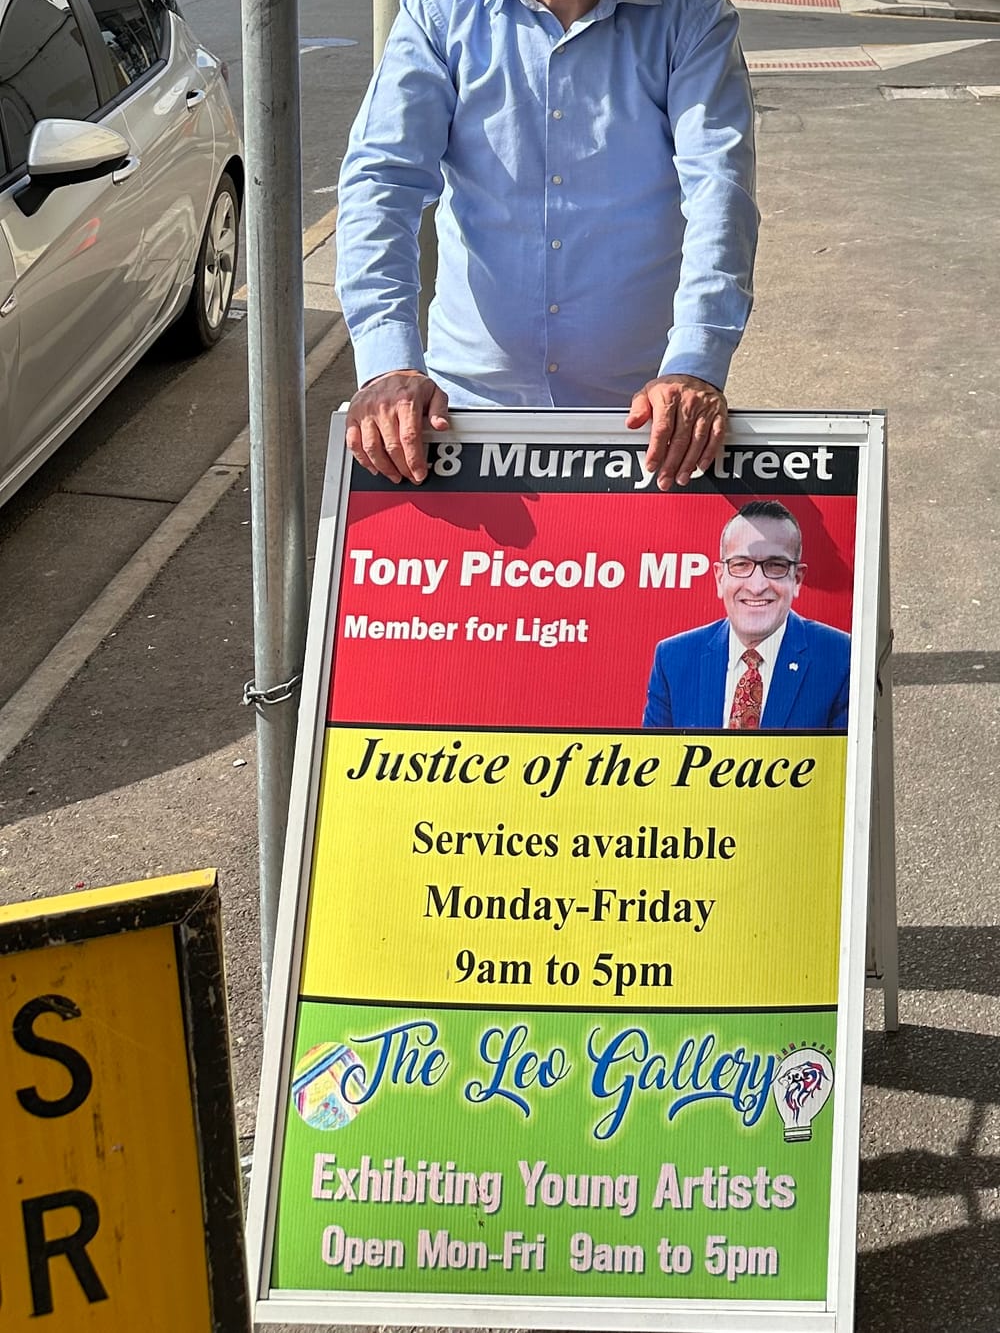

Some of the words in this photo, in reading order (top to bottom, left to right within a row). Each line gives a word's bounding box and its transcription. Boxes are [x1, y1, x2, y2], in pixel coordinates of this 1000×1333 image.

[479, 443, 656, 490] Murray
[690, 446, 834, 481] treet
[350, 550, 449, 594] Tony
[460, 550, 625, 589] Piccolo
[639, 552, 710, 589] MP
[344, 615, 459, 641] Member
[465, 615, 508, 641] for
[515, 617, 588, 647] Light
[347, 736, 508, 787] Justice
[523, 741, 583, 798] of
[587, 742, 658, 787] the
[672, 744, 816, 788] Peace
[413, 820, 559, 859] Services
[572, 827, 737, 860] available
[424, 883, 716, 932] Monday-Friday
[456, 949, 532, 986] 9am
[546, 955, 579, 986] to
[593, 952, 673, 997] 5pm
[341, 1020, 449, 1105] The
[465, 1025, 571, 1118] Leo
[588, 1027, 779, 1140] Gallery
[312, 1152, 502, 1213] Exhibiting
[518, 1160, 639, 1217] Young
[654, 1162, 796, 1211] Artists
[321, 1225, 404, 1275] Open
[418, 1229, 546, 1272] Mon-Fri
[569, 1232, 645, 1275] 9am
[658, 1237, 692, 1275] to
[704, 1236, 779, 1282] 5pm
